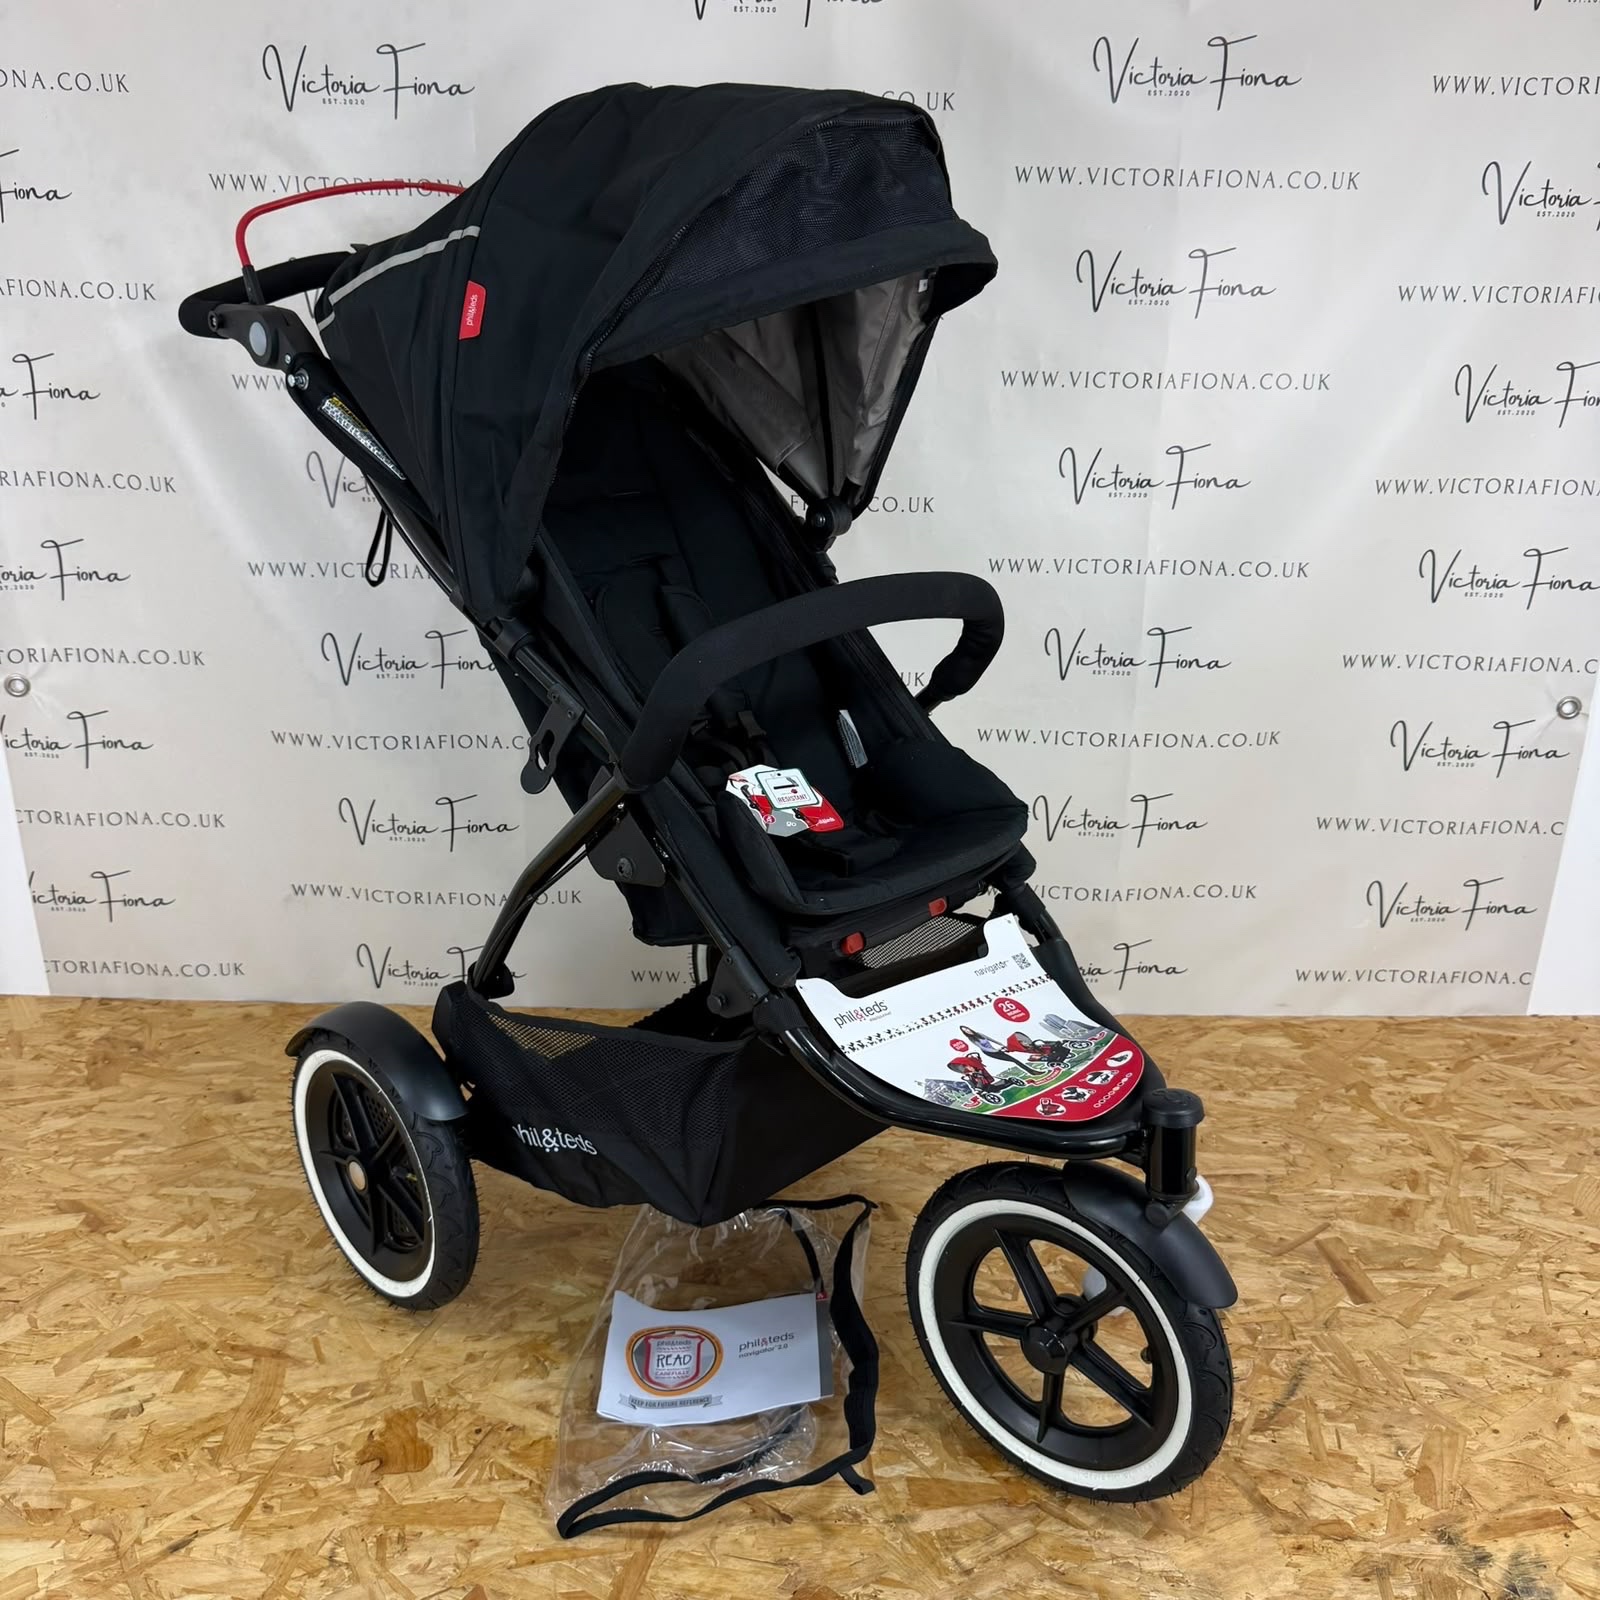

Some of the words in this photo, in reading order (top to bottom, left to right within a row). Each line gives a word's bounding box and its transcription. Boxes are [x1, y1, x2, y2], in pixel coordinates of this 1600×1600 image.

[262, 44, 380, 112] Victoria
[376, 42, 475, 120] Fiona
[1093, 36, 1207, 104] Victoria
[1207, 35, 1302, 111] Fiona
[1015, 166, 1361, 190] WWW.VICTORIAFIONA.CO.UK
[1482, 160, 1592, 225] Victoria
[0, 278, 157, 301] FIONA.CO.UK
[1076, 250, 1187, 313] Victoria
[1188, 247, 1277, 319] Fiona
[1398, 286, 1600, 304] WWW.VICTORIAFI
[12, 352, 101, 420] Fiona
[1001, 371, 1331, 391] WWW.VICTORIAFIONA.CO.UK
[1455, 364, 1553, 424] Victoria
[1059, 447, 1164, 505] Victoria
[1166, 443, 1252, 510] Fiona
[1375, 478, 1600, 497] WWW.VICTORIAFION
[40, 538, 131, 601] Fiona
[247, 561, 432, 580] WWW.VICTORIA
[988, 558, 1310, 578] WWW.VICTORIAFIONA.CO.UK
[1419, 548, 1520, 604] Victoria
[1521, 547, 1600, 610] Fiona
[0, 648, 206, 666] ORIAFIONA.CO.UK
[320, 632, 429, 686] Victoria
[1044, 628, 1147, 681] Victoria
[1147, 627, 1232, 689] Fiona
[0, 714, 72, 751] ictoria
[66, 710, 154, 769] Fiona
[977, 728, 1281, 749] WWW.VICTORIAFIONA.CO.UK
[1391, 720, 1490, 771] Victoria
[1491, 719, 1570, 778] Fiona
[338, 797, 439, 846] Victoria
[435, 794, 520, 852] Fiona
[1032, 795, 1130, 842] Victoria
[1130, 793, 1208, 848] Fiona
[28, 871, 97, 906] ictoria
[91, 870, 176, 923] Fiona
[291, 883, 583, 907] WWW.VICTORIAFIONAO.UK
[1366, 880, 1460, 929] Victoria
[1461, 877, 1538, 931] Fiona
[44, 959, 245, 978] TORIAFIONA.CO.UK
[356, 943, 450, 989] Victoria
[1113, 938, 1187, 991] Fiona
[833, 1001, 888, 1029] phil&teds
[998, 1000, 1016, 1013] 26
[656, 1353, 692, 1368] READ
[739, 1332, 795, 1353] phil&teds
